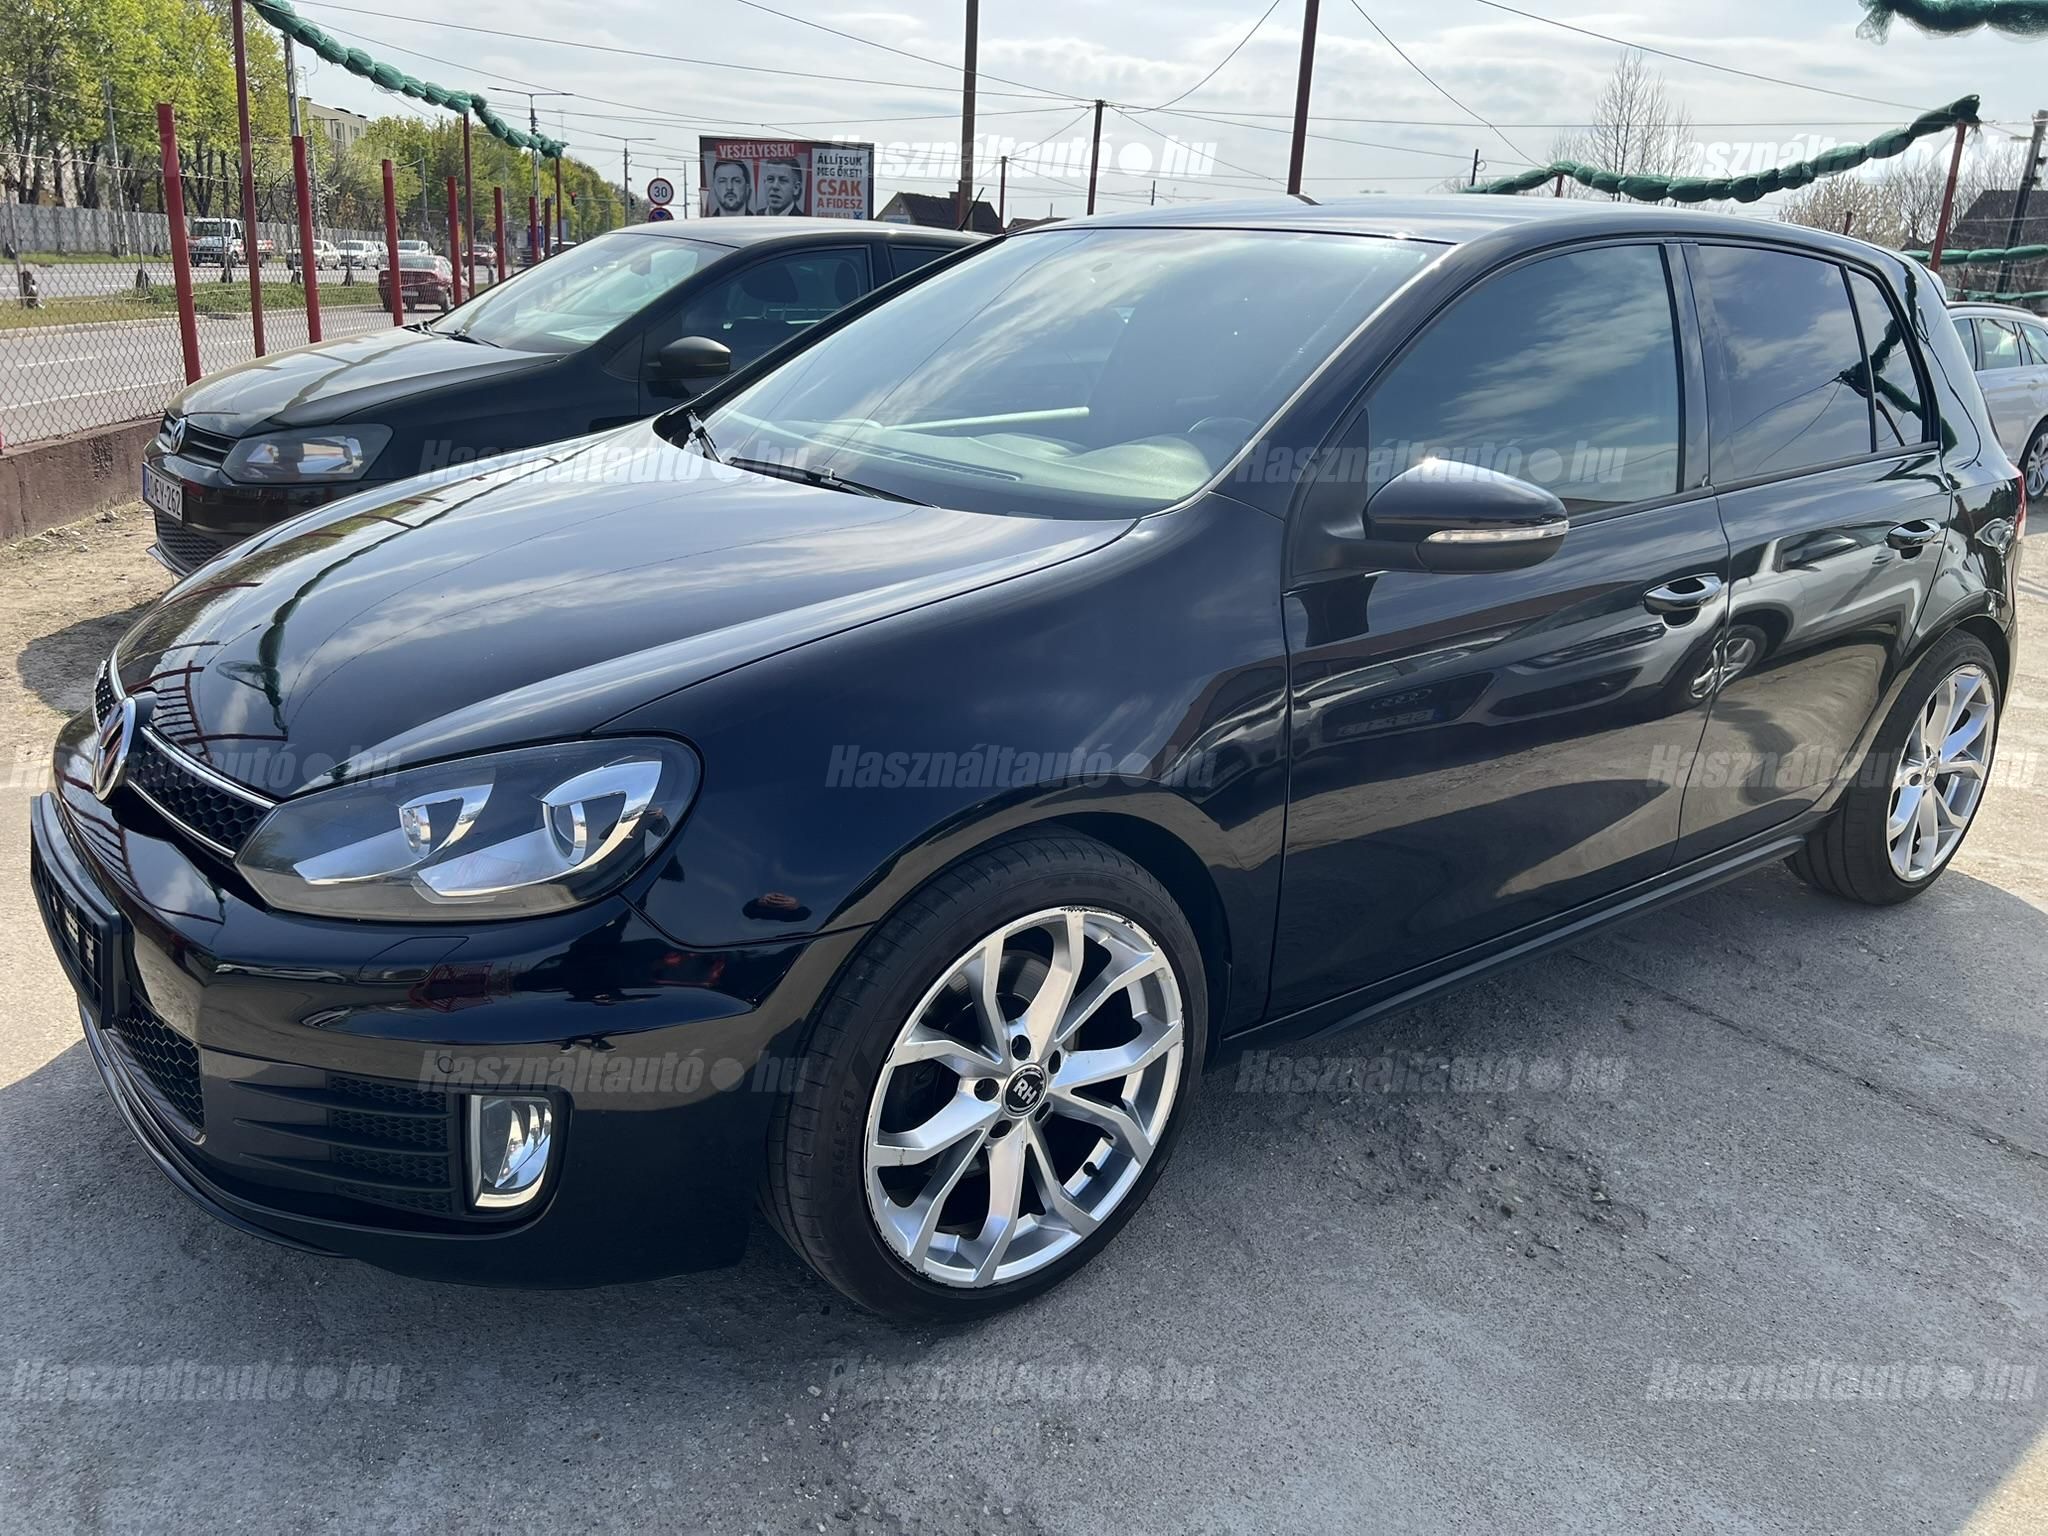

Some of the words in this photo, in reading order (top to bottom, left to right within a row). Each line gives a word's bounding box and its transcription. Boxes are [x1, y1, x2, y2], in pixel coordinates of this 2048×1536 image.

[719, 142, 795, 158] VESZÉLYESEK!
[817, 153, 862, 166] ÁLLÍTSUK
[816, 167, 835, 176] MEG
[654, 186, 668, 198] 30
[816, 178, 862, 197] CSAK
[817, 197, 825, 208] A
[826, 198, 863, 209] FIDESZ
[1013, 1077, 1037, 1105] RH
